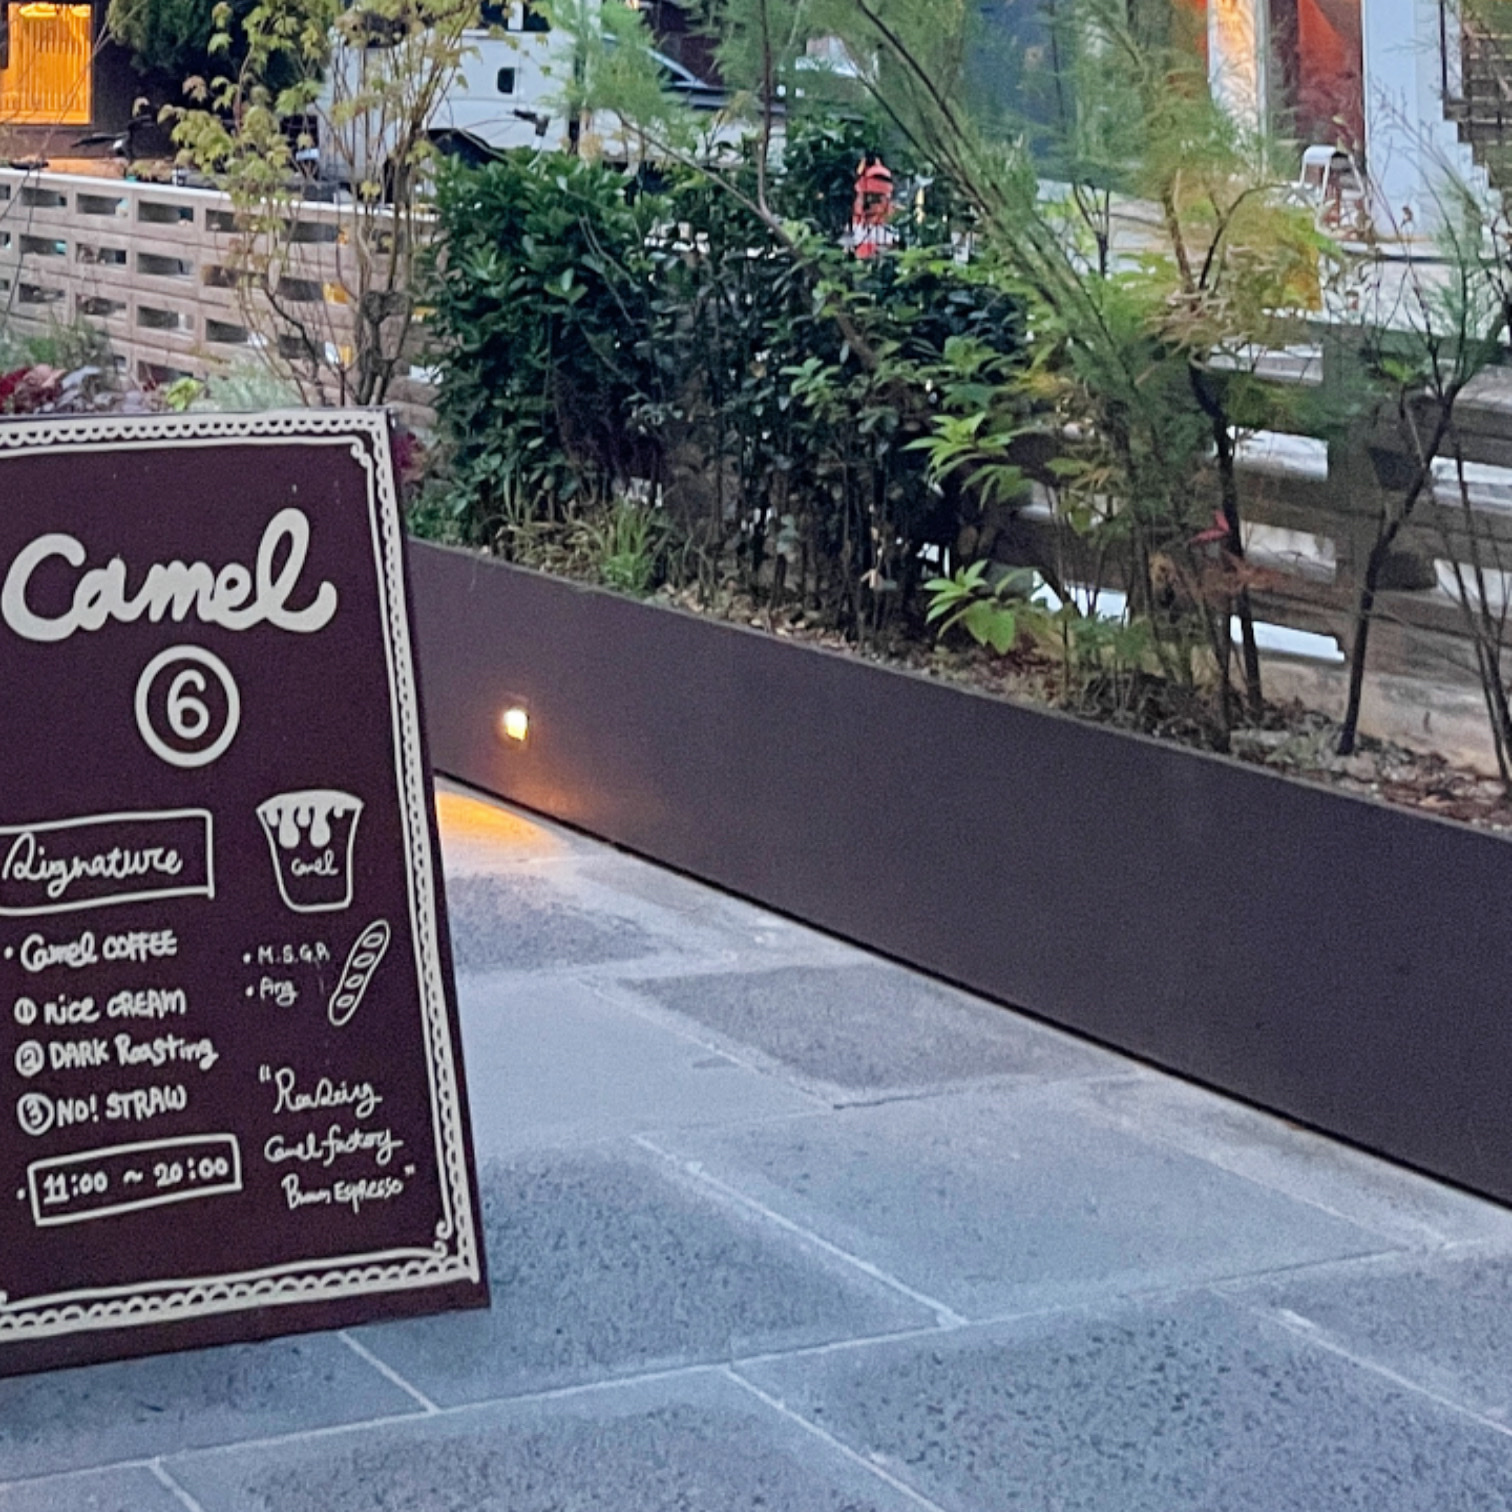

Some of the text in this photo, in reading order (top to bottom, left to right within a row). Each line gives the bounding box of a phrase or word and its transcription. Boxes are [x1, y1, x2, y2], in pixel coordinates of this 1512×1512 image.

[1, 507, 338, 642] Camel
[20, 929, 178, 972] Camel COFFEE
[44, 994, 100, 1025] nice
[106, 988, 186, 1019] CREAM
[49, 1038, 110, 1070] DARK
[114, 1033, 219, 1070] Roasting
[57, 1094, 99, 1127] NO!
[105, 1084, 187, 1121] STRAW
[43, 1171, 108, 1205] 11:00
[153, 1156, 229, 1188] 20:00
